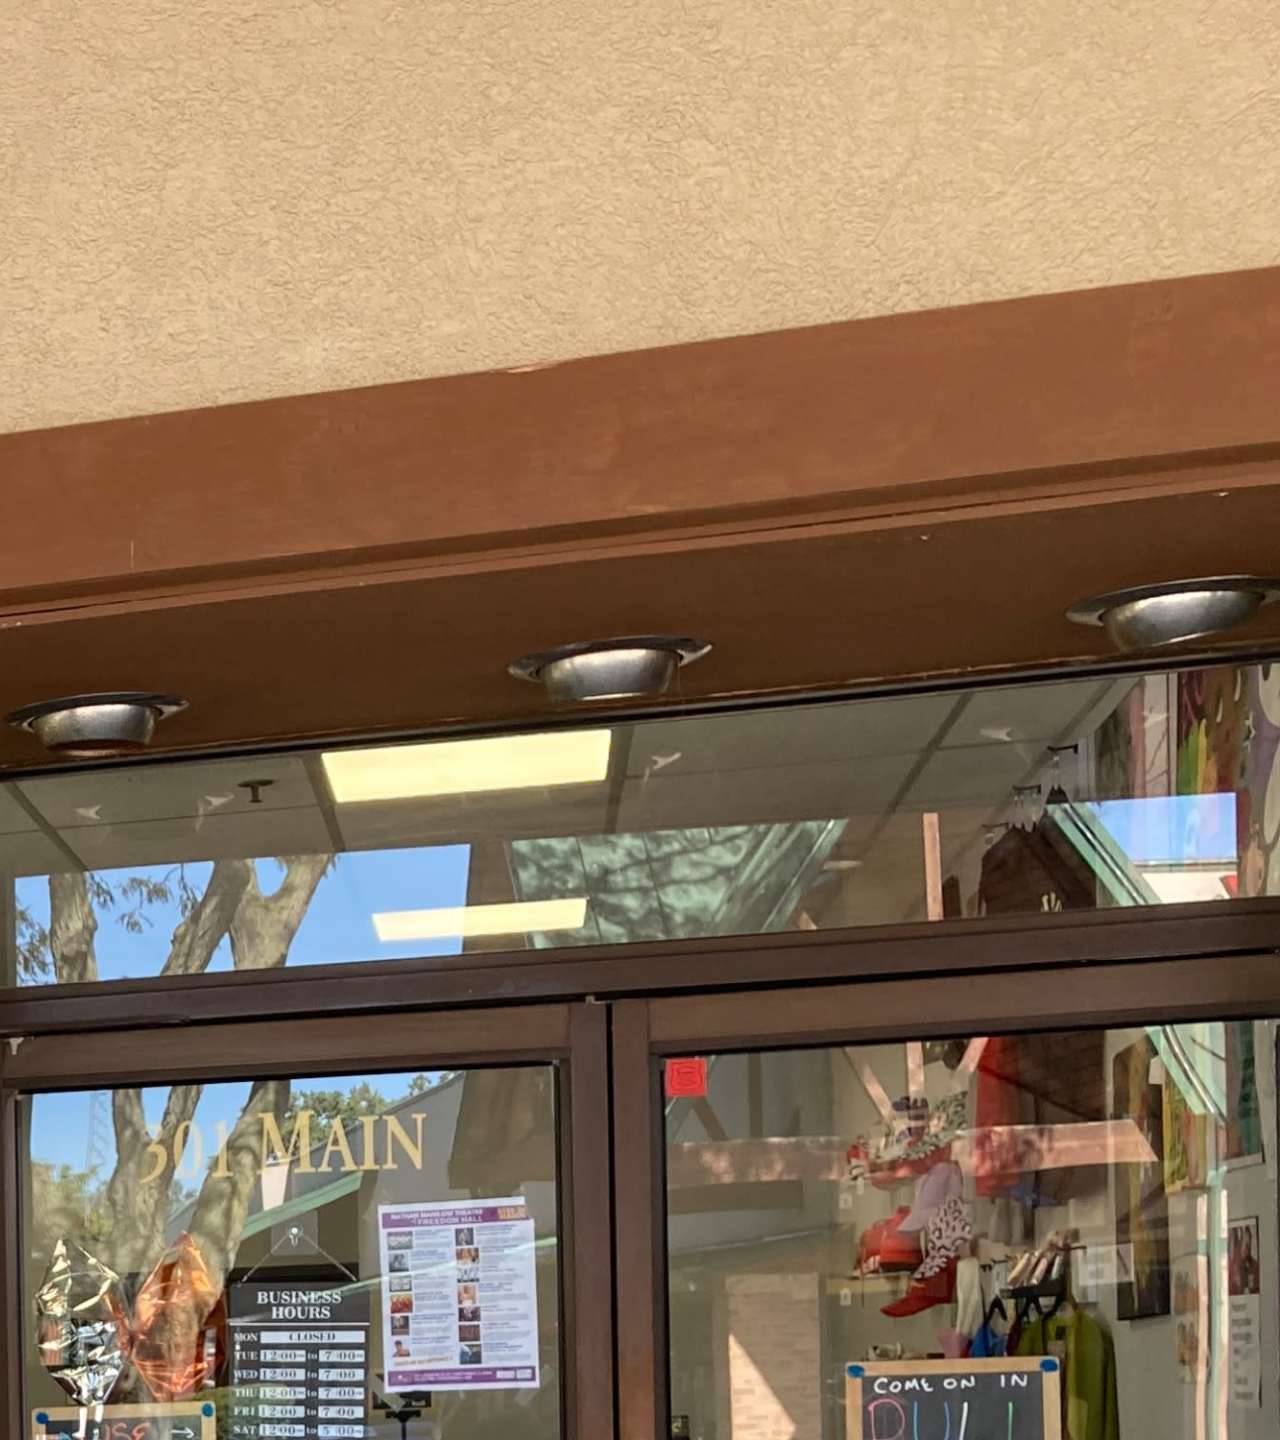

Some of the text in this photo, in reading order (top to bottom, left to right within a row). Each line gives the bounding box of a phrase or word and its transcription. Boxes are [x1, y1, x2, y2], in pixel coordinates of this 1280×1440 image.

[139, 1109, 428, 1184] 301 MAIN
[257, 1290, 342, 1304] BUSINESS
[271, 1306, 331, 1319] HOURS
[234, 1332, 336, 1341] MON CLOSED
[234, 1351, 258, 1360] TUE
[307, 1351, 317, 1360] to
[233, 1369, 258, 1379] WED
[307, 1369, 317, 1379] to
[873, 1373, 1028, 1394] COME ON IN
[234, 1388, 255, 1398] THU
[307, 1388, 317, 1397] to
[233, 1407, 256, 1416] FRI
[306, 1407, 317, 1416] to
[233, 1425, 257, 1435] SAT
[306, 1426, 317, 1435] to
